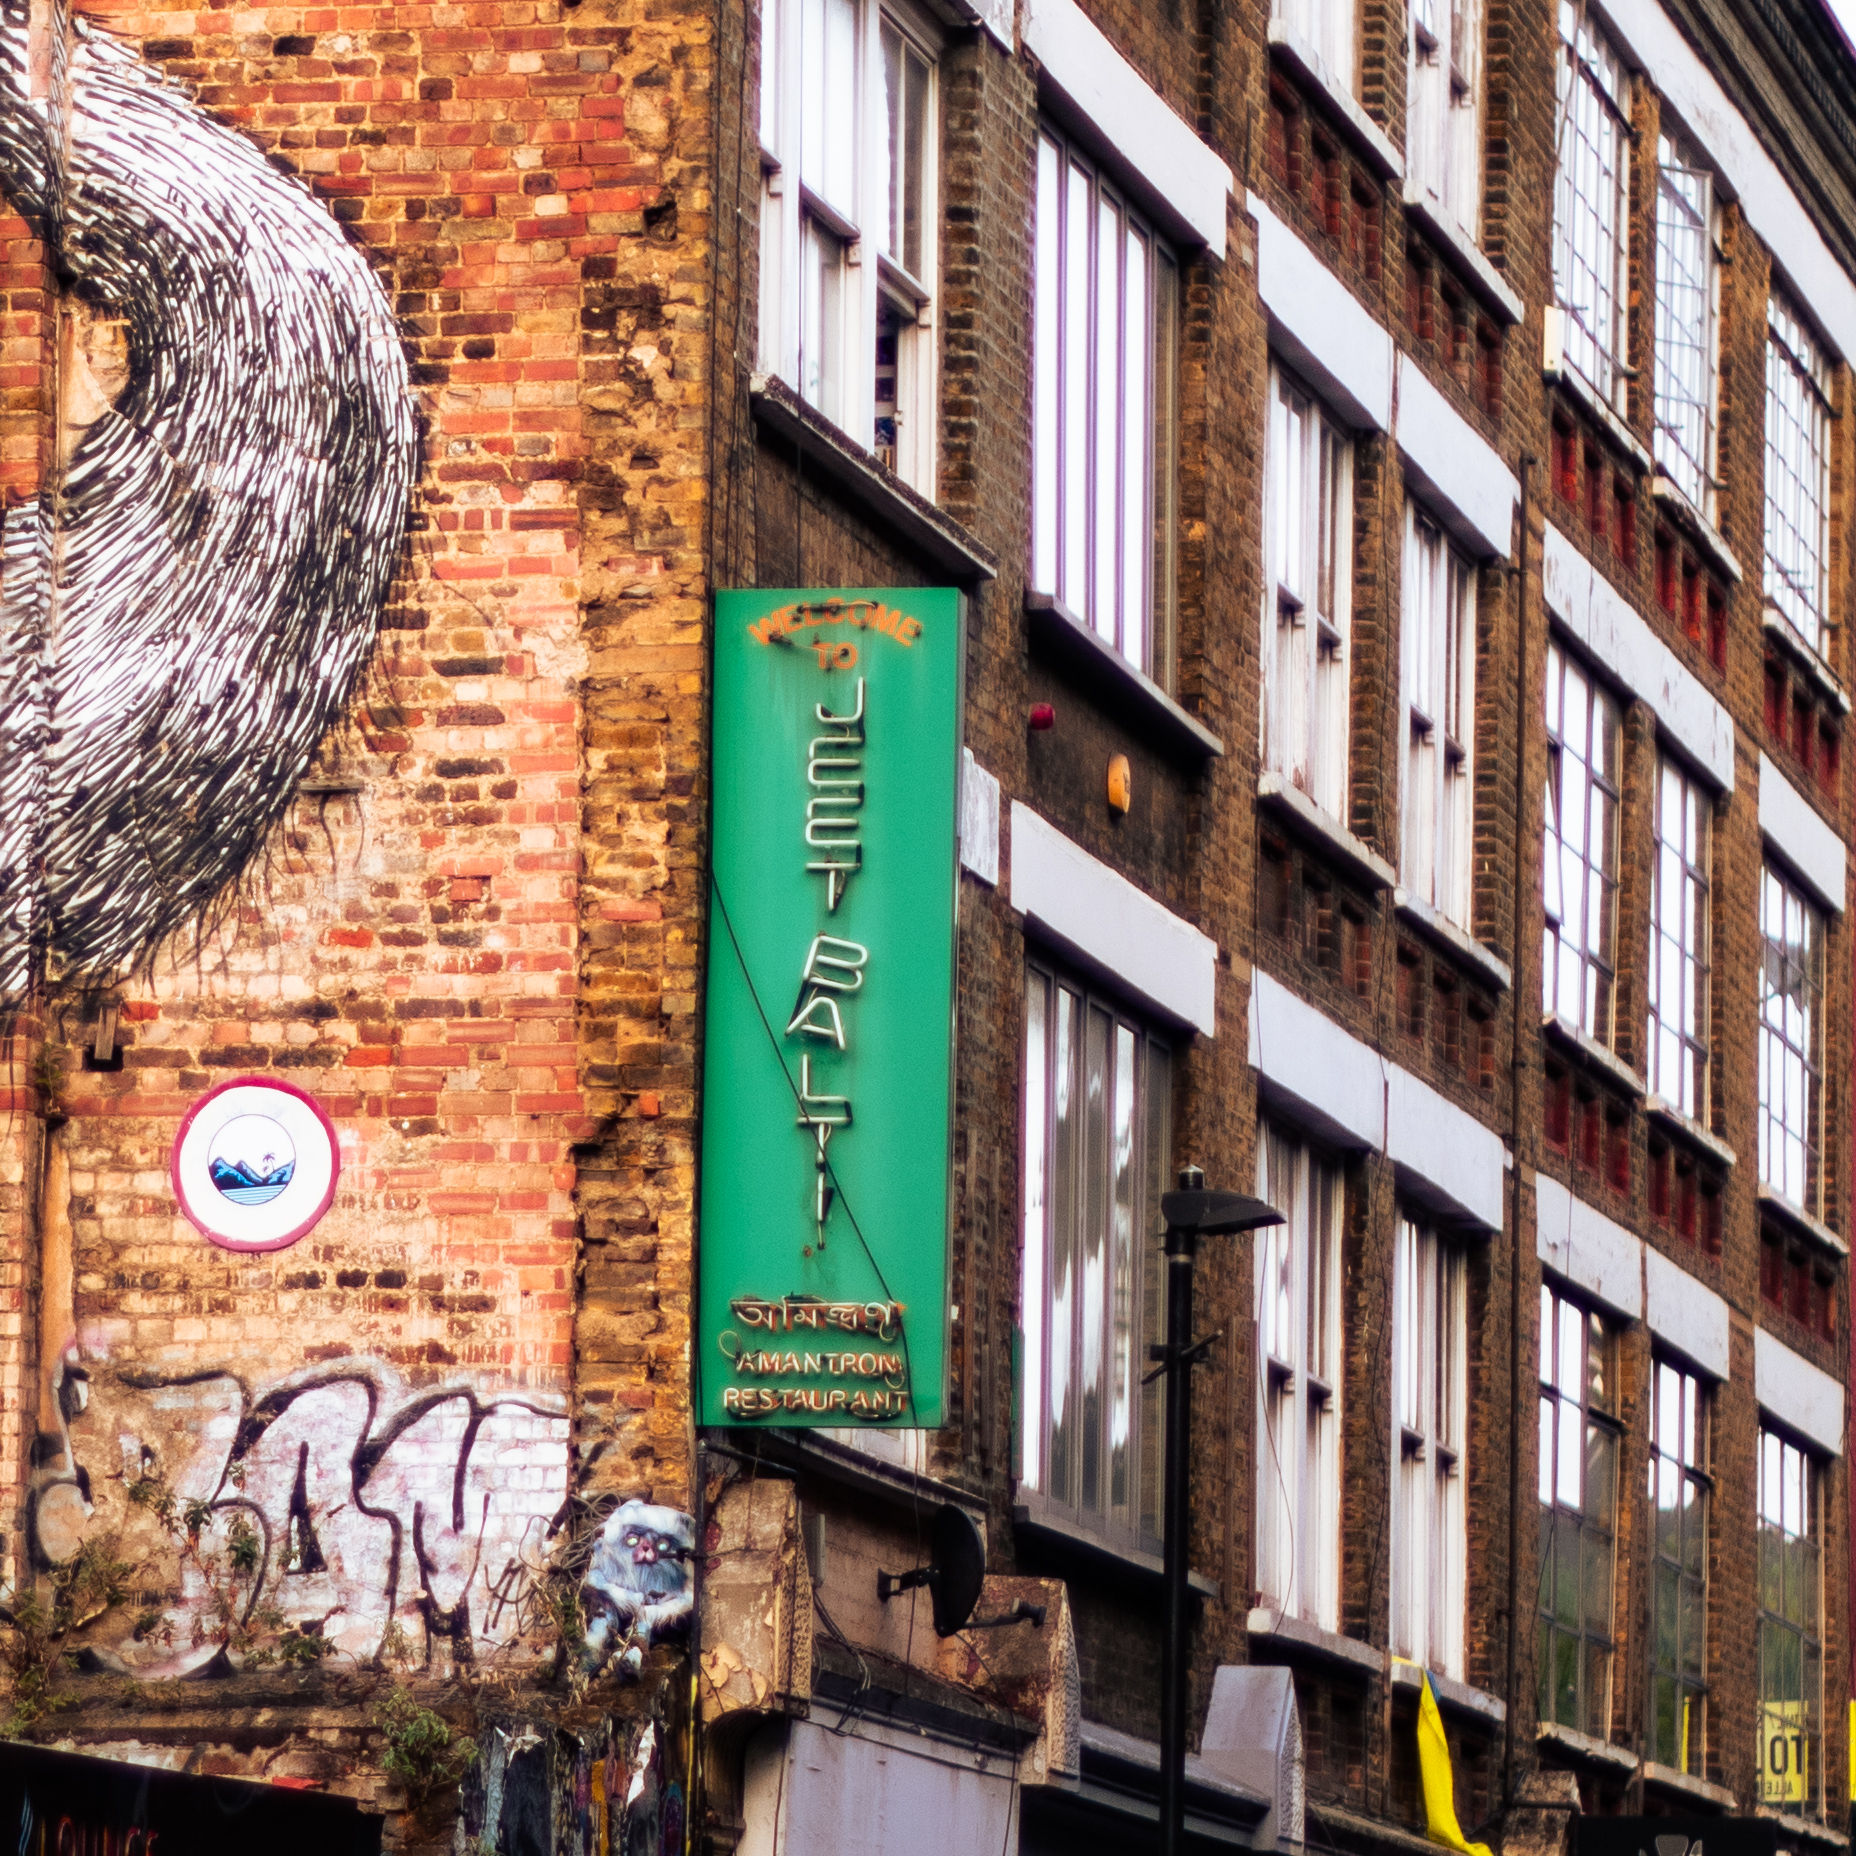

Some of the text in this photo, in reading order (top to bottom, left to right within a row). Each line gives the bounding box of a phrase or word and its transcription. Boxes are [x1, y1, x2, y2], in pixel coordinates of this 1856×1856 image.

[748, 598, 922, 647] WELCOME
[812, 642, 858, 670] TO
[785, 934, 869, 1222] BALTI
[736, 1350, 903, 1377] AMANTRON
[723, 1387, 909, 1411] RESTAURANT
